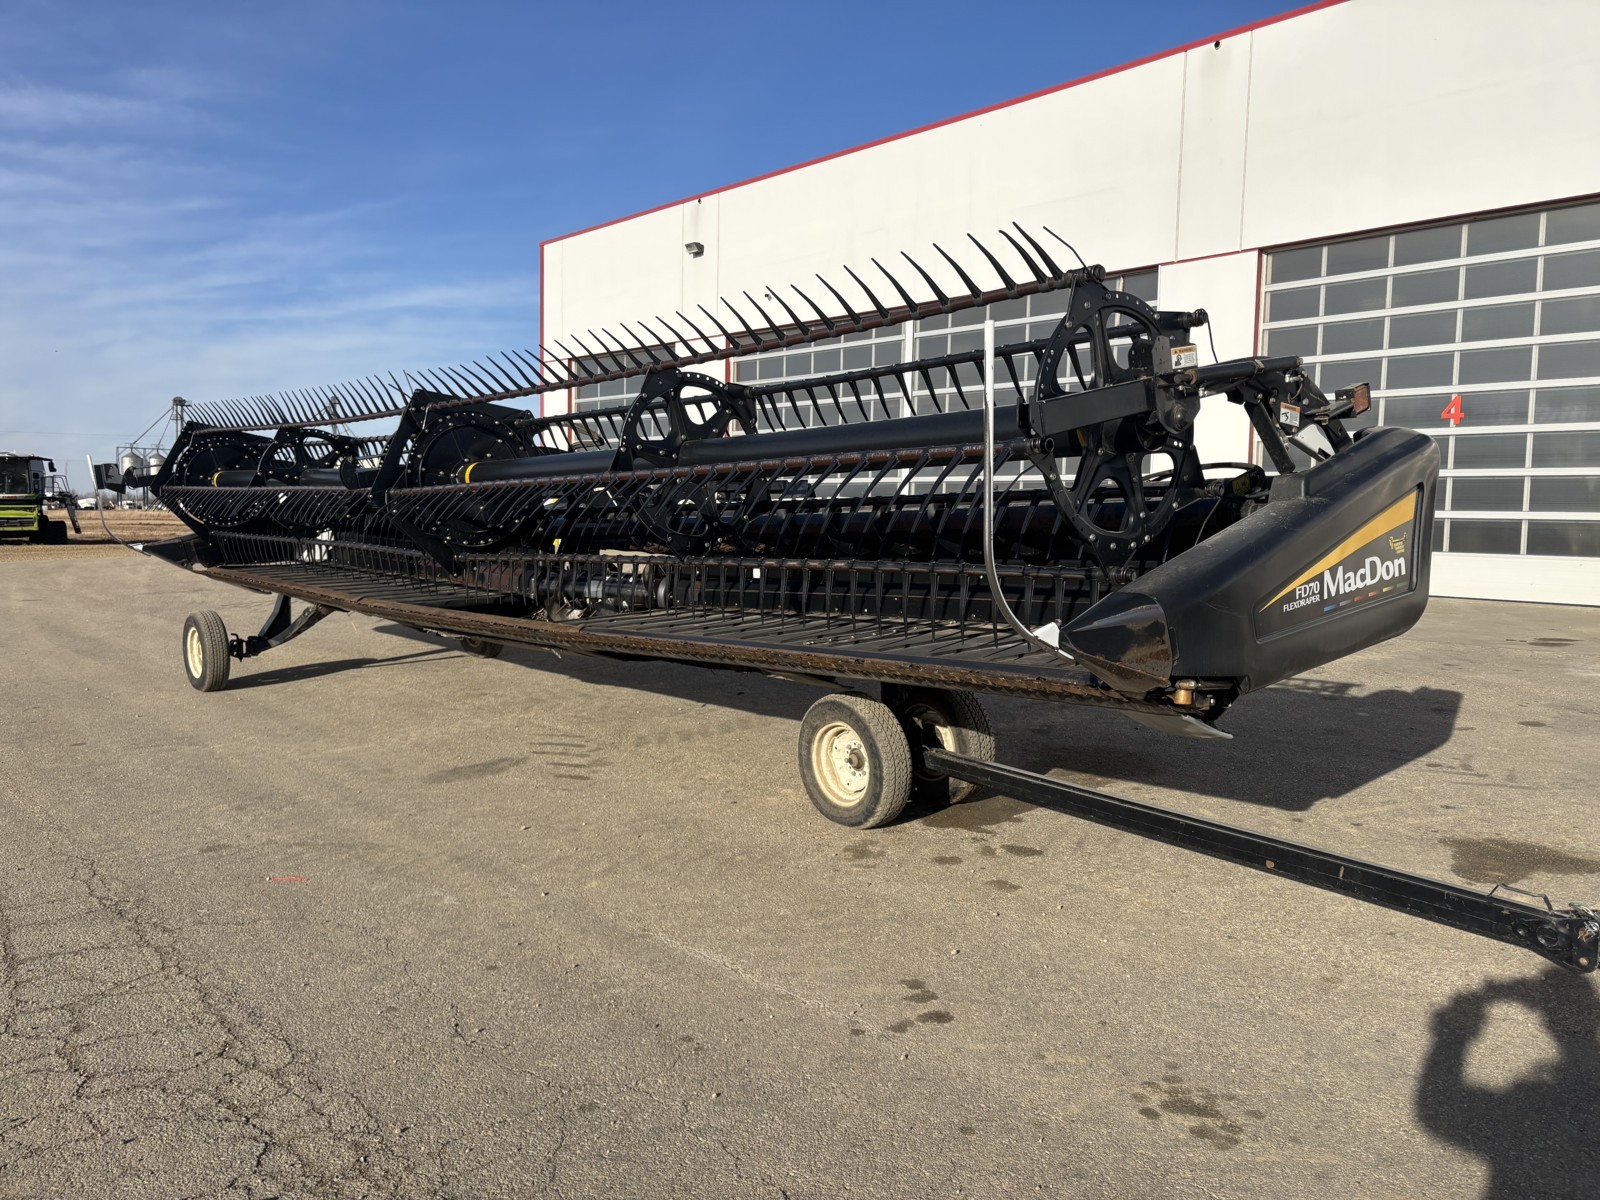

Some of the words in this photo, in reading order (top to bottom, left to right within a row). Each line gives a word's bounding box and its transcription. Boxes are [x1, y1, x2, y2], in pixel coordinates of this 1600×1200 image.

[1441, 395, 1465, 425] 4
[1323, 556, 1406, 599] MacDon
[1295, 581, 1320, 600] FD70
[1283, 594, 1321, 613] FLEXDRAPER
